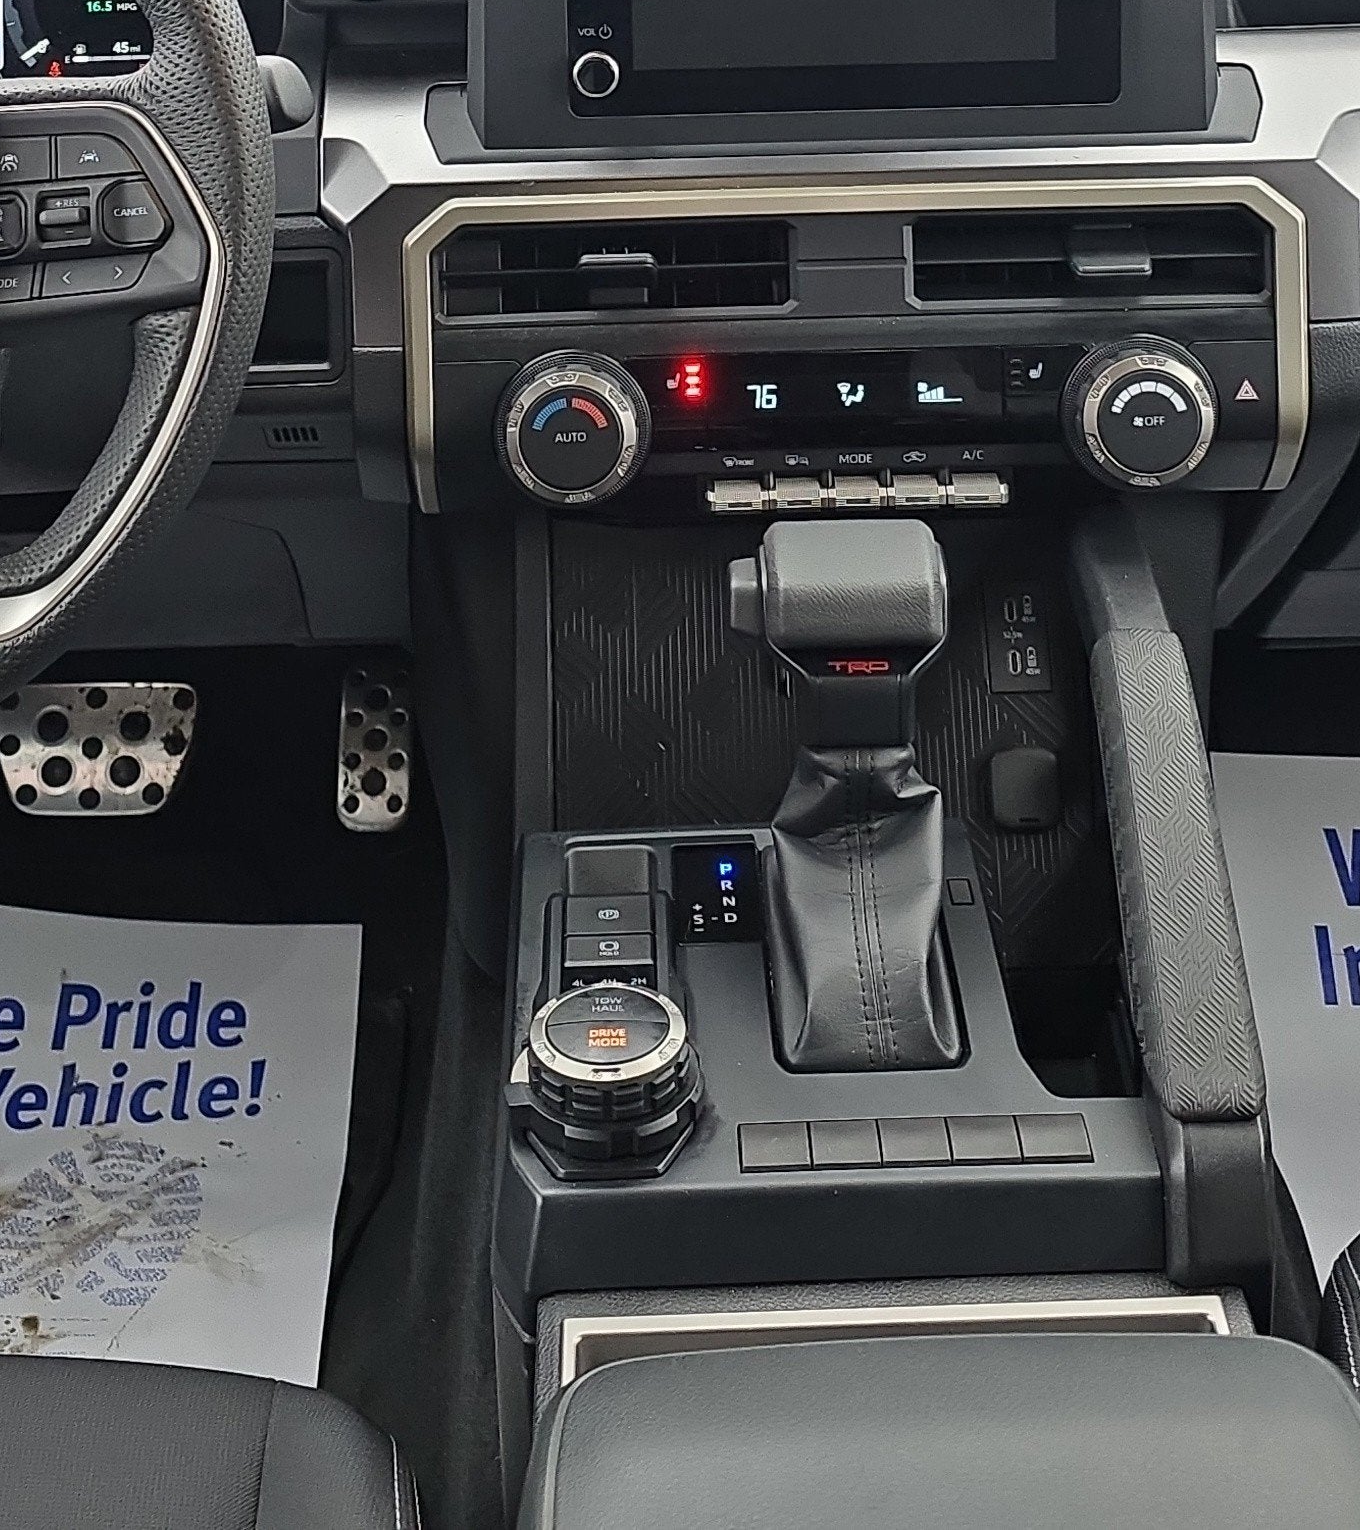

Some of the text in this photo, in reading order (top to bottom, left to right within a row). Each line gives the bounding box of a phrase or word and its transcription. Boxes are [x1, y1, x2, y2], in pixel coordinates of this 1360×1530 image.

[86, 1, 138, 12] 16.5 MPG
[578, 28, 597, 37] VOL
[112, 41, 129, 54] 45
[64, 55, 71, 64] E
[113, 206, 149, 217] CANCEL
[746, 384, 778, 409] 76
[1144, 416, 1166, 426] OFF
[554, 432, 587, 443] AUTO
[838, 453, 873, 464] MODE
[962, 449, 984, 461] A/C
[827, 661, 889, 674] TRD
[720, 863, 733, 875] P
[720, 880, 734, 891] R
[723, 896, 736, 907] N
[693, 913, 738, 925] S D
[630, 978, 647, 986] 2H
[594, 996, 623, 1005] TOW
[592, 1004, 625, 1012] HAUL
[51, 980, 248, 1051] Pride
[589, 1028, 627, 1038] DRIVE
[588, 1037, 627, 1047] MODE
